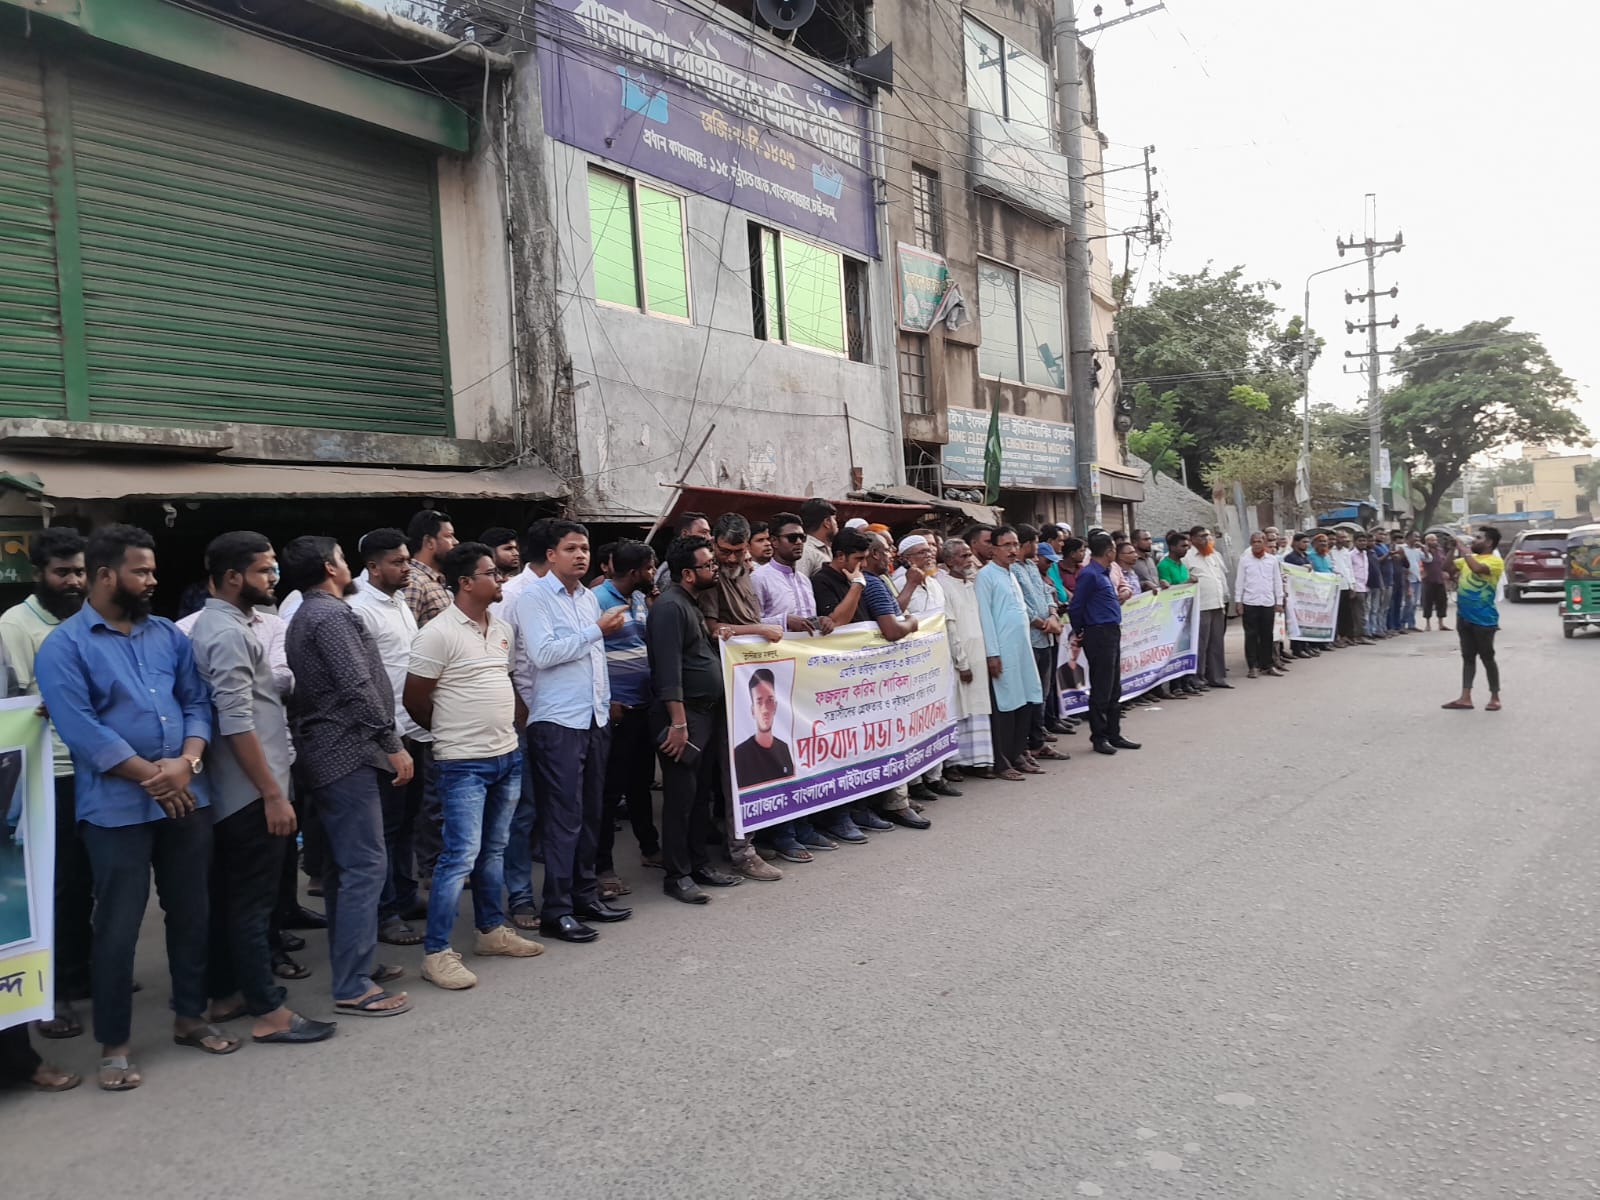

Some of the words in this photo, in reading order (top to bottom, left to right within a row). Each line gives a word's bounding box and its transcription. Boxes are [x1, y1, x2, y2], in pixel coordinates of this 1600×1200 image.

[796, 719, 858, 769] প্রতিবাদ
[862, 717, 893, 753] সভা
[896, 718, 906, 743] ও
[791, 778, 836, 807] বাংলাদেশ
[838, 767, 881, 795] লাইটারেজ
[882, 760, 905, 780] শ্রমিক
